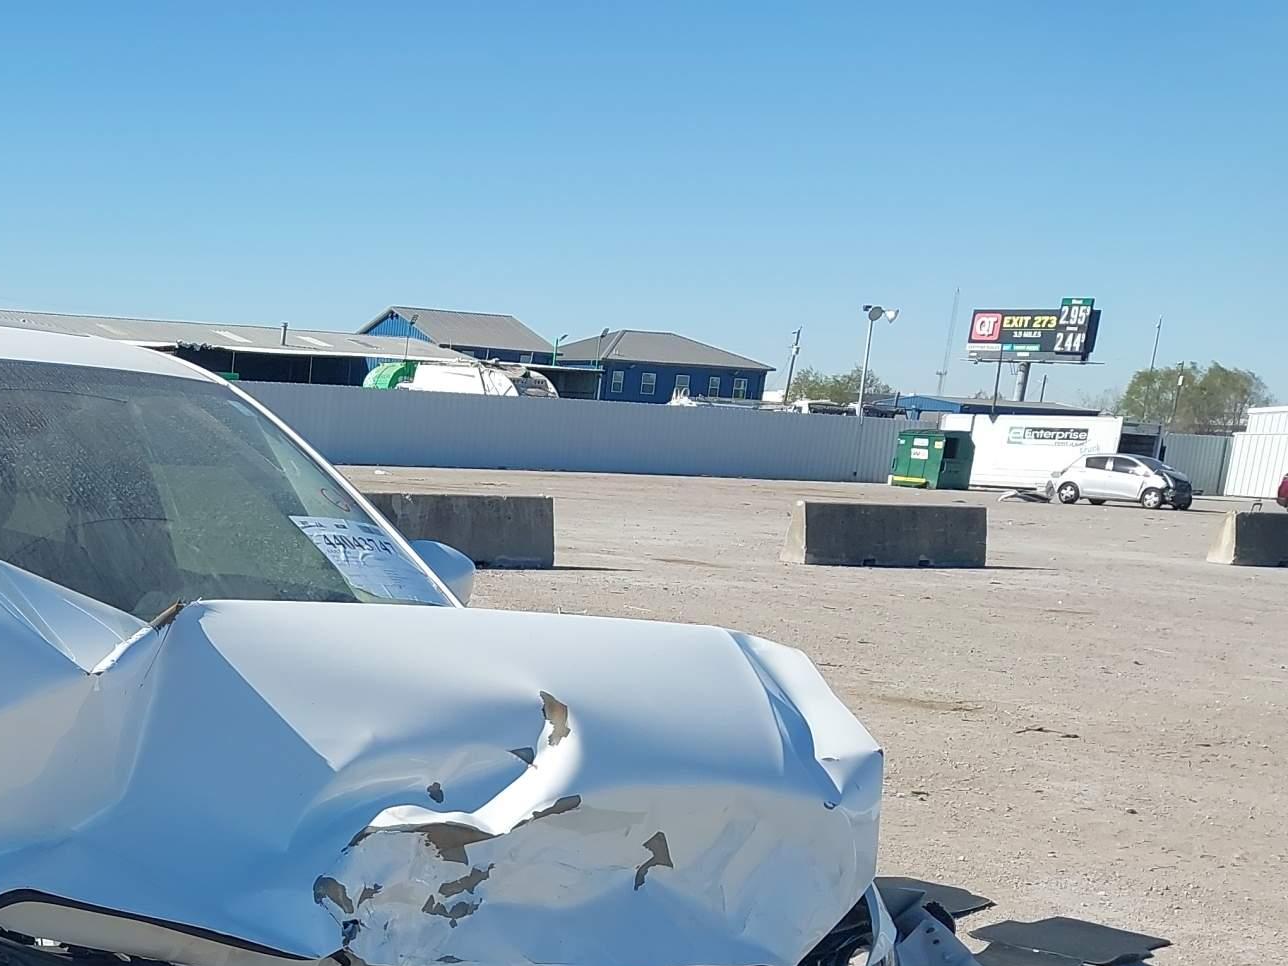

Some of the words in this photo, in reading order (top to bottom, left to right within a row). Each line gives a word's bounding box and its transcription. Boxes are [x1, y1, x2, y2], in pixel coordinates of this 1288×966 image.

[975, 317, 998, 336] QT
[1002, 316, 1031, 327] EXIT
[1032, 316, 1057, 327] 273
[1024, 429, 1088, 440] Enterprise
[323, 534, 396, 555] 44043747
